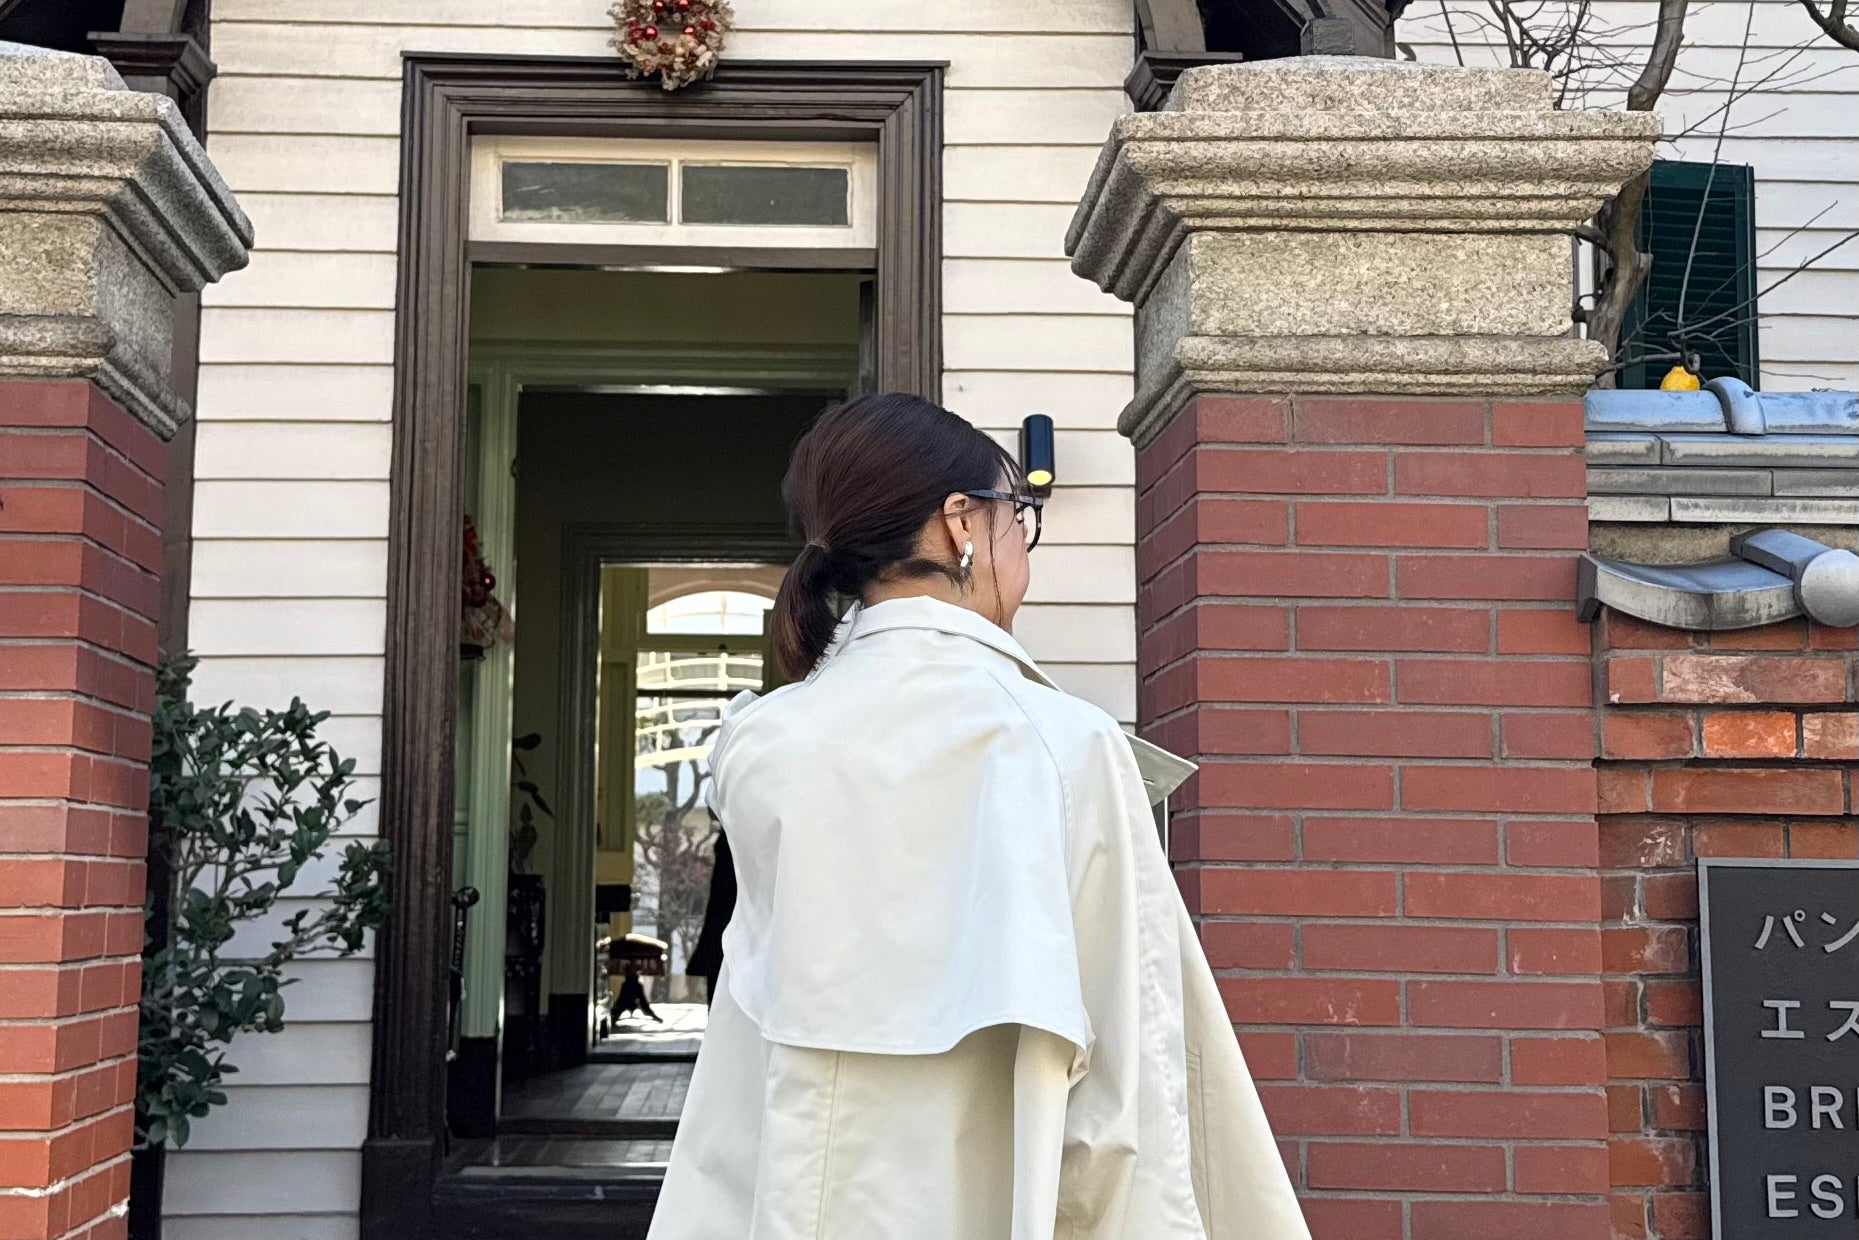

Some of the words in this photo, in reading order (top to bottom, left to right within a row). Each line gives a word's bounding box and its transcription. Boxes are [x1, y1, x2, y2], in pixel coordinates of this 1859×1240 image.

[1754, 909, 1859, 953] パン
[1760, 999, 1859, 1042] エス
[1763, 1085, 1859, 1129] BR
[1766, 1174, 1859, 1219] ES
